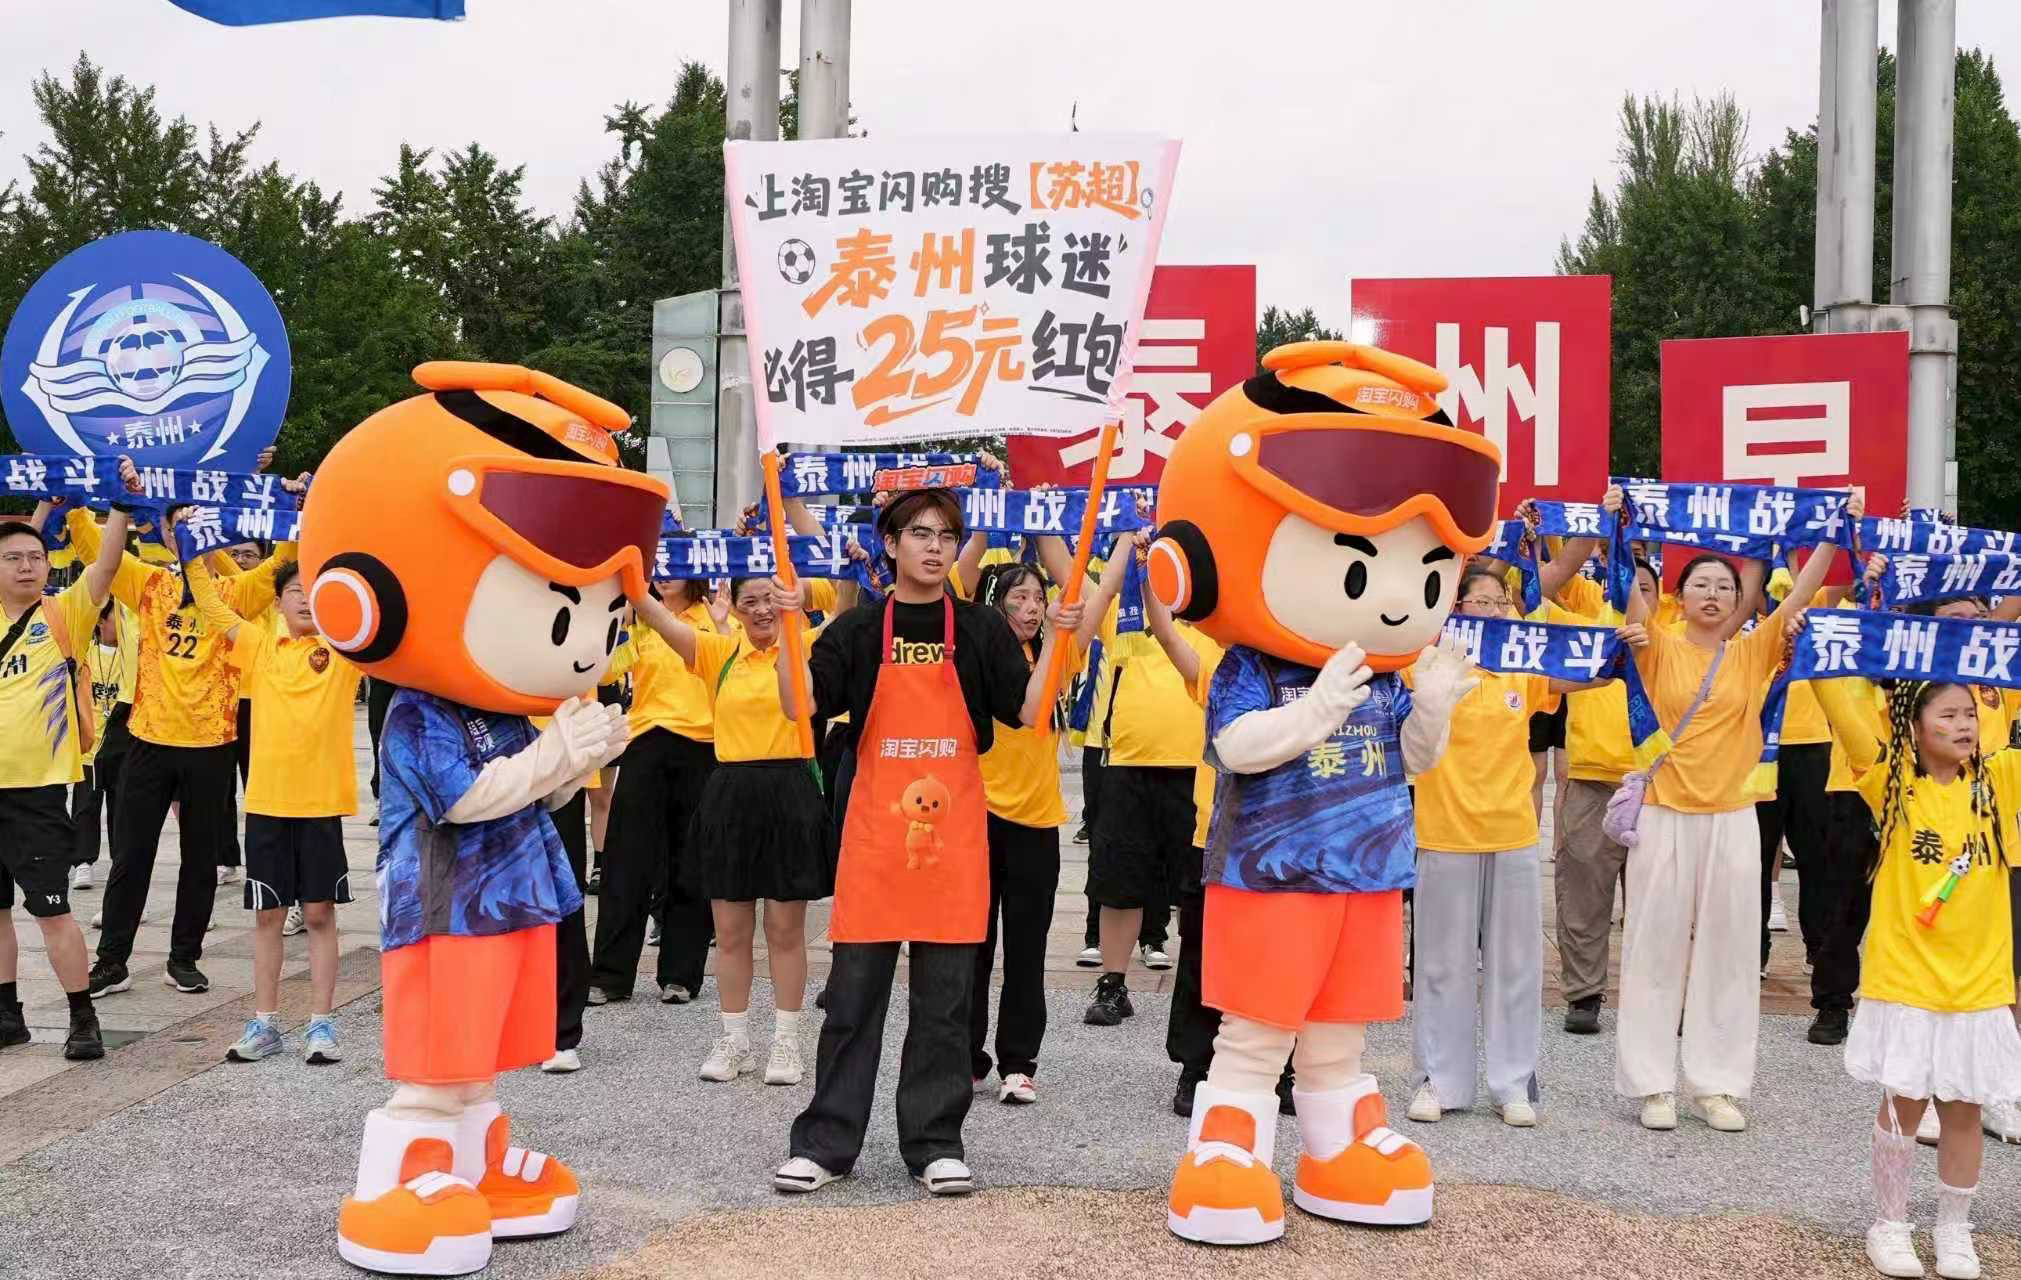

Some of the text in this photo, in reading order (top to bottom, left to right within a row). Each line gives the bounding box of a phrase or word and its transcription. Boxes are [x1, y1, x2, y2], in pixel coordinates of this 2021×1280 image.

[801, 221, 1113, 319] 泰州球迷
[764, 304, 1128, 417] 必得25元红包
[1058, 319, 1211, 479] 泰
[1436, 321, 1560, 486] 州
[124, 416, 185, 449] 泰州
[5, 457, 100, 493] 战斗
[140, 466, 276, 510] 州战斗
[187, 506, 303, 550] 泰州
[1625, 484, 1848, 539] 泰州战斗
[1855, 517, 2015, 555] 州战斗
[167, 633, 198, 659] 22
[891, 637, 956, 665] drew
[1808, 615, 2021, 681] 泰州战
[880, 737, 958, 760] 淘宝闪购
[1308, 741, 1387, 778] 泰州
[1912, 829, 1992, 865] 泰州
[46, 895, 61, 905] Y-3
